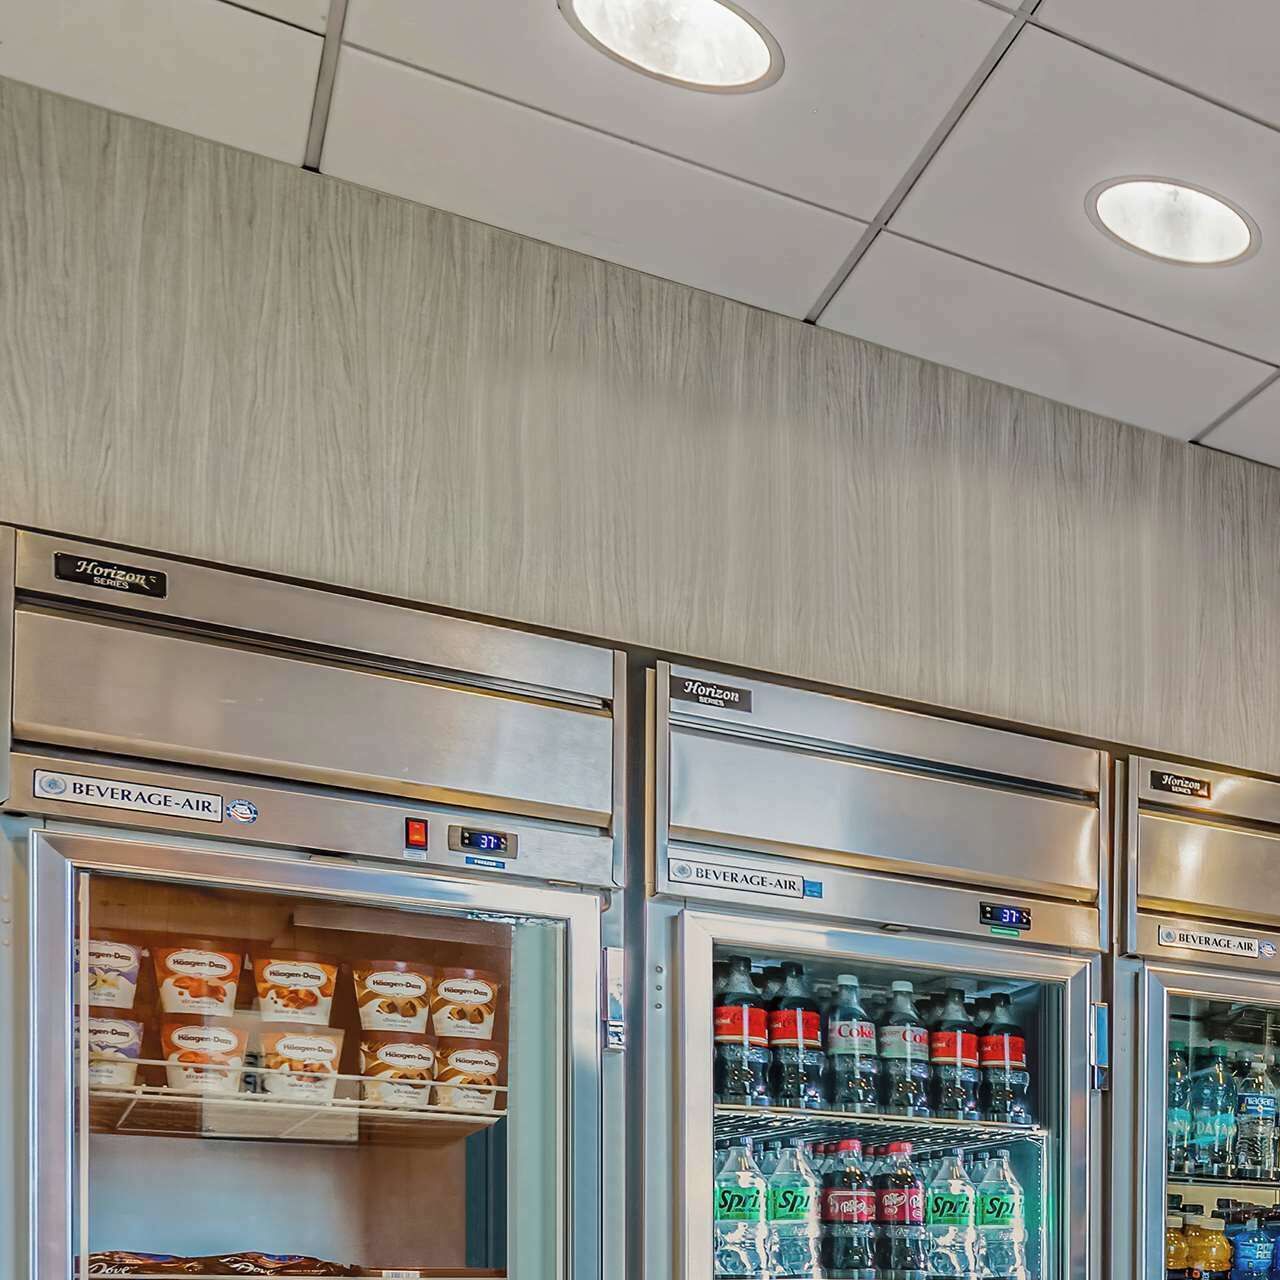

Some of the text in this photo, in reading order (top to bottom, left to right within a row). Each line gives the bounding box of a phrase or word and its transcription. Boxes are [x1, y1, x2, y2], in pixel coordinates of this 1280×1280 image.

[76, 560, 147, 586] Horizon
[94, 577, 128, 590] SERIES
[684, 681, 740, 703] Horizon
[1162, 774, 1201, 791] Horizon
[72, 782, 214, 814] BEVERAGE-AIR
[696, 867, 797, 891] BEVERAGE-AIR
[1178, 932, 1254, 951] BEVERAGE-AIR
[837, 1022, 874, 1038] Coke
